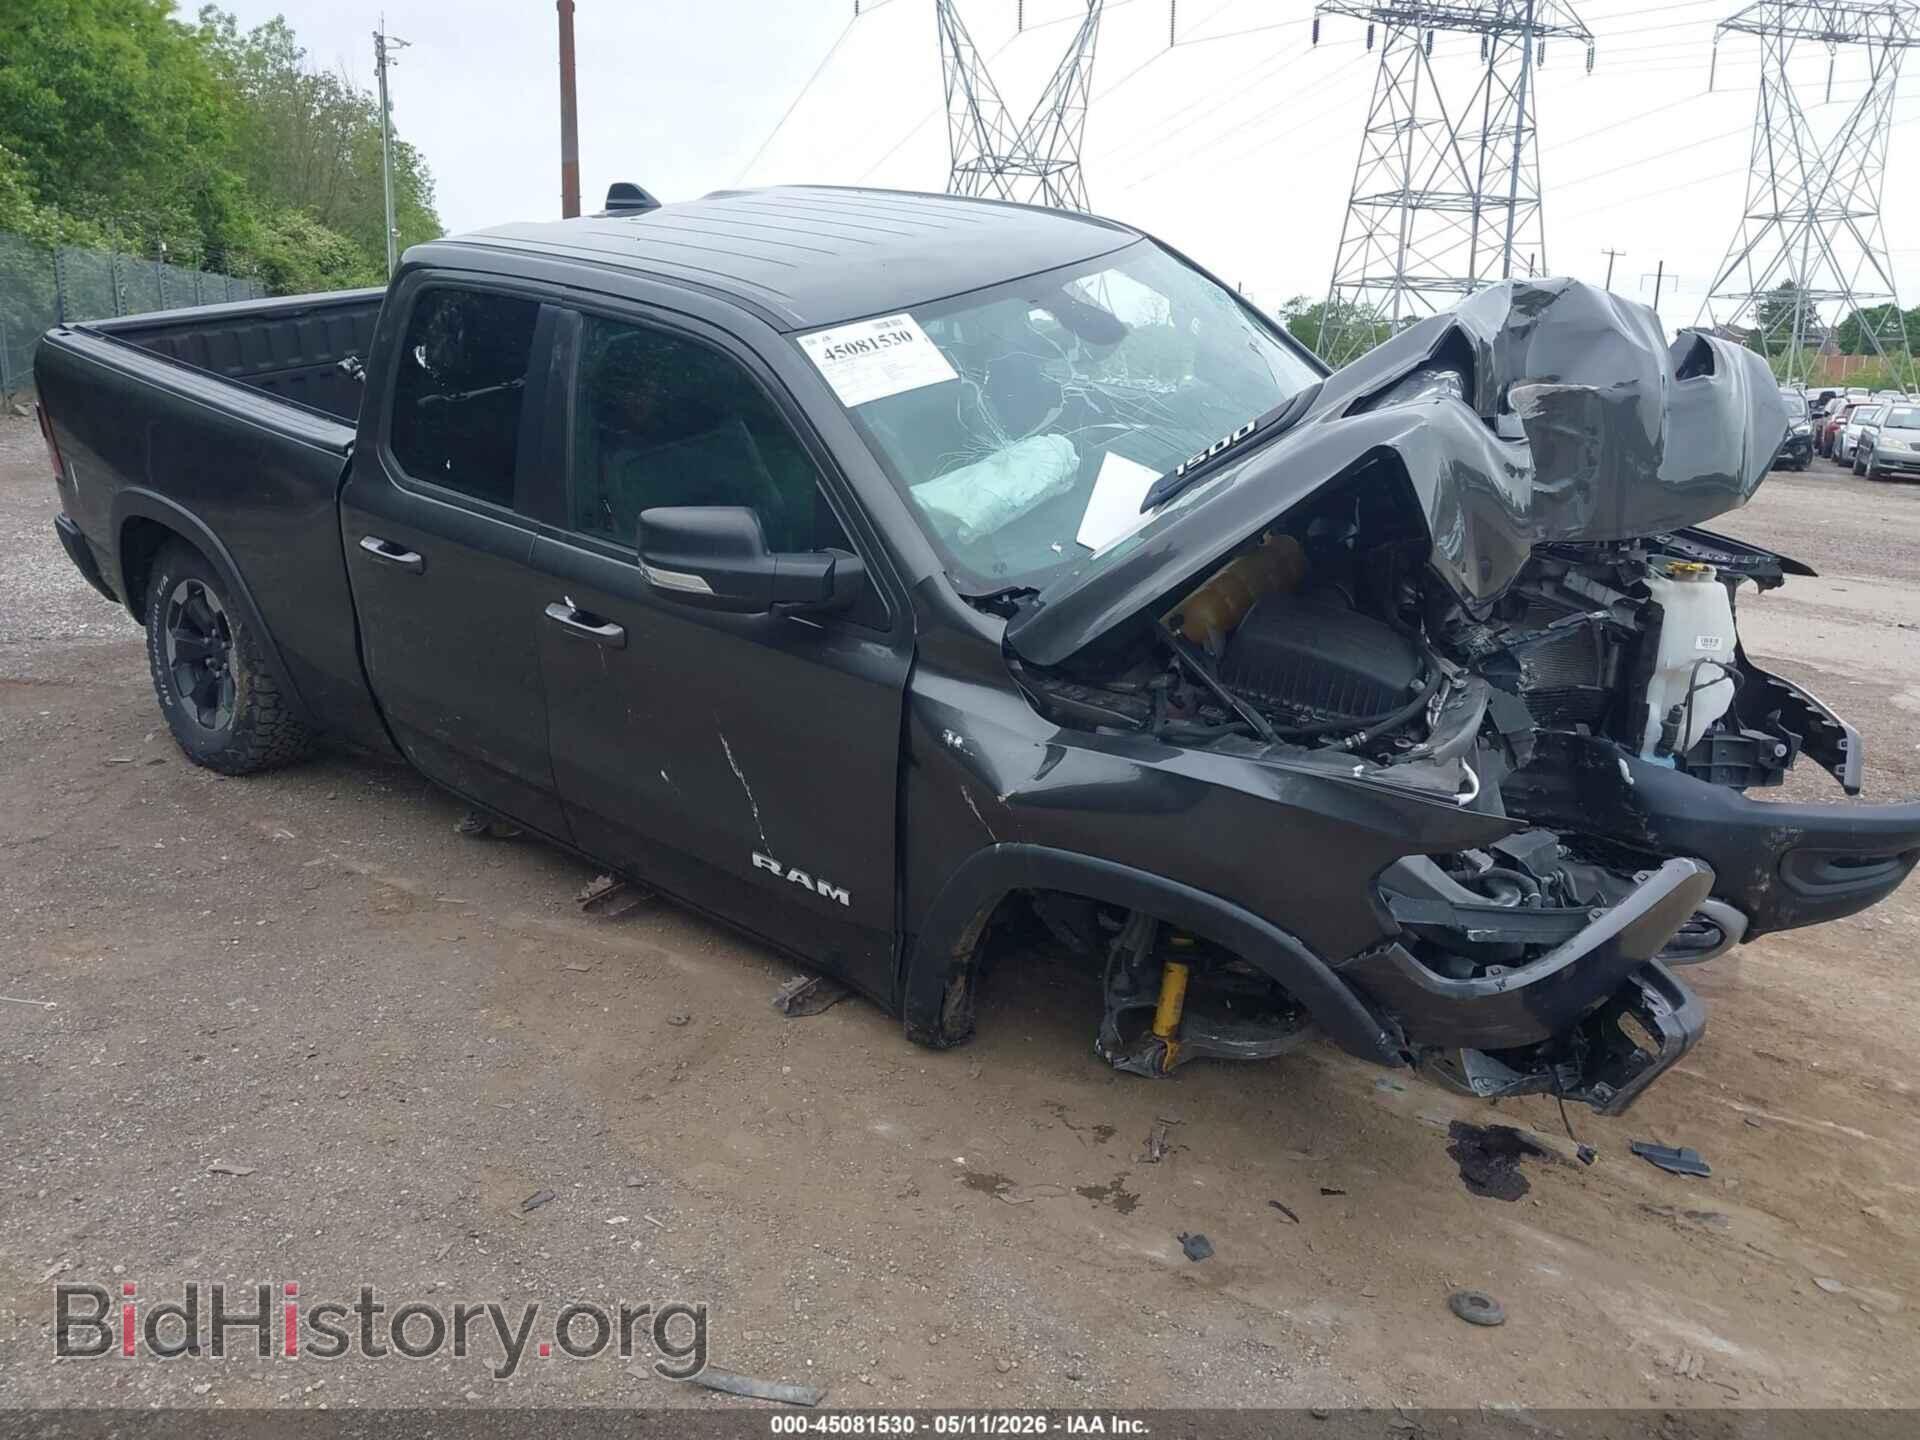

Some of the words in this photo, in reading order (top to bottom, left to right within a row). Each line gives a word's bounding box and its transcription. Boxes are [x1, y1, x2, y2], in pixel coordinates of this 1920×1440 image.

[823, 329, 913, 361] 45081530
[1175, 419, 1256, 477] 1500
[752, 851, 851, 906] RAM
